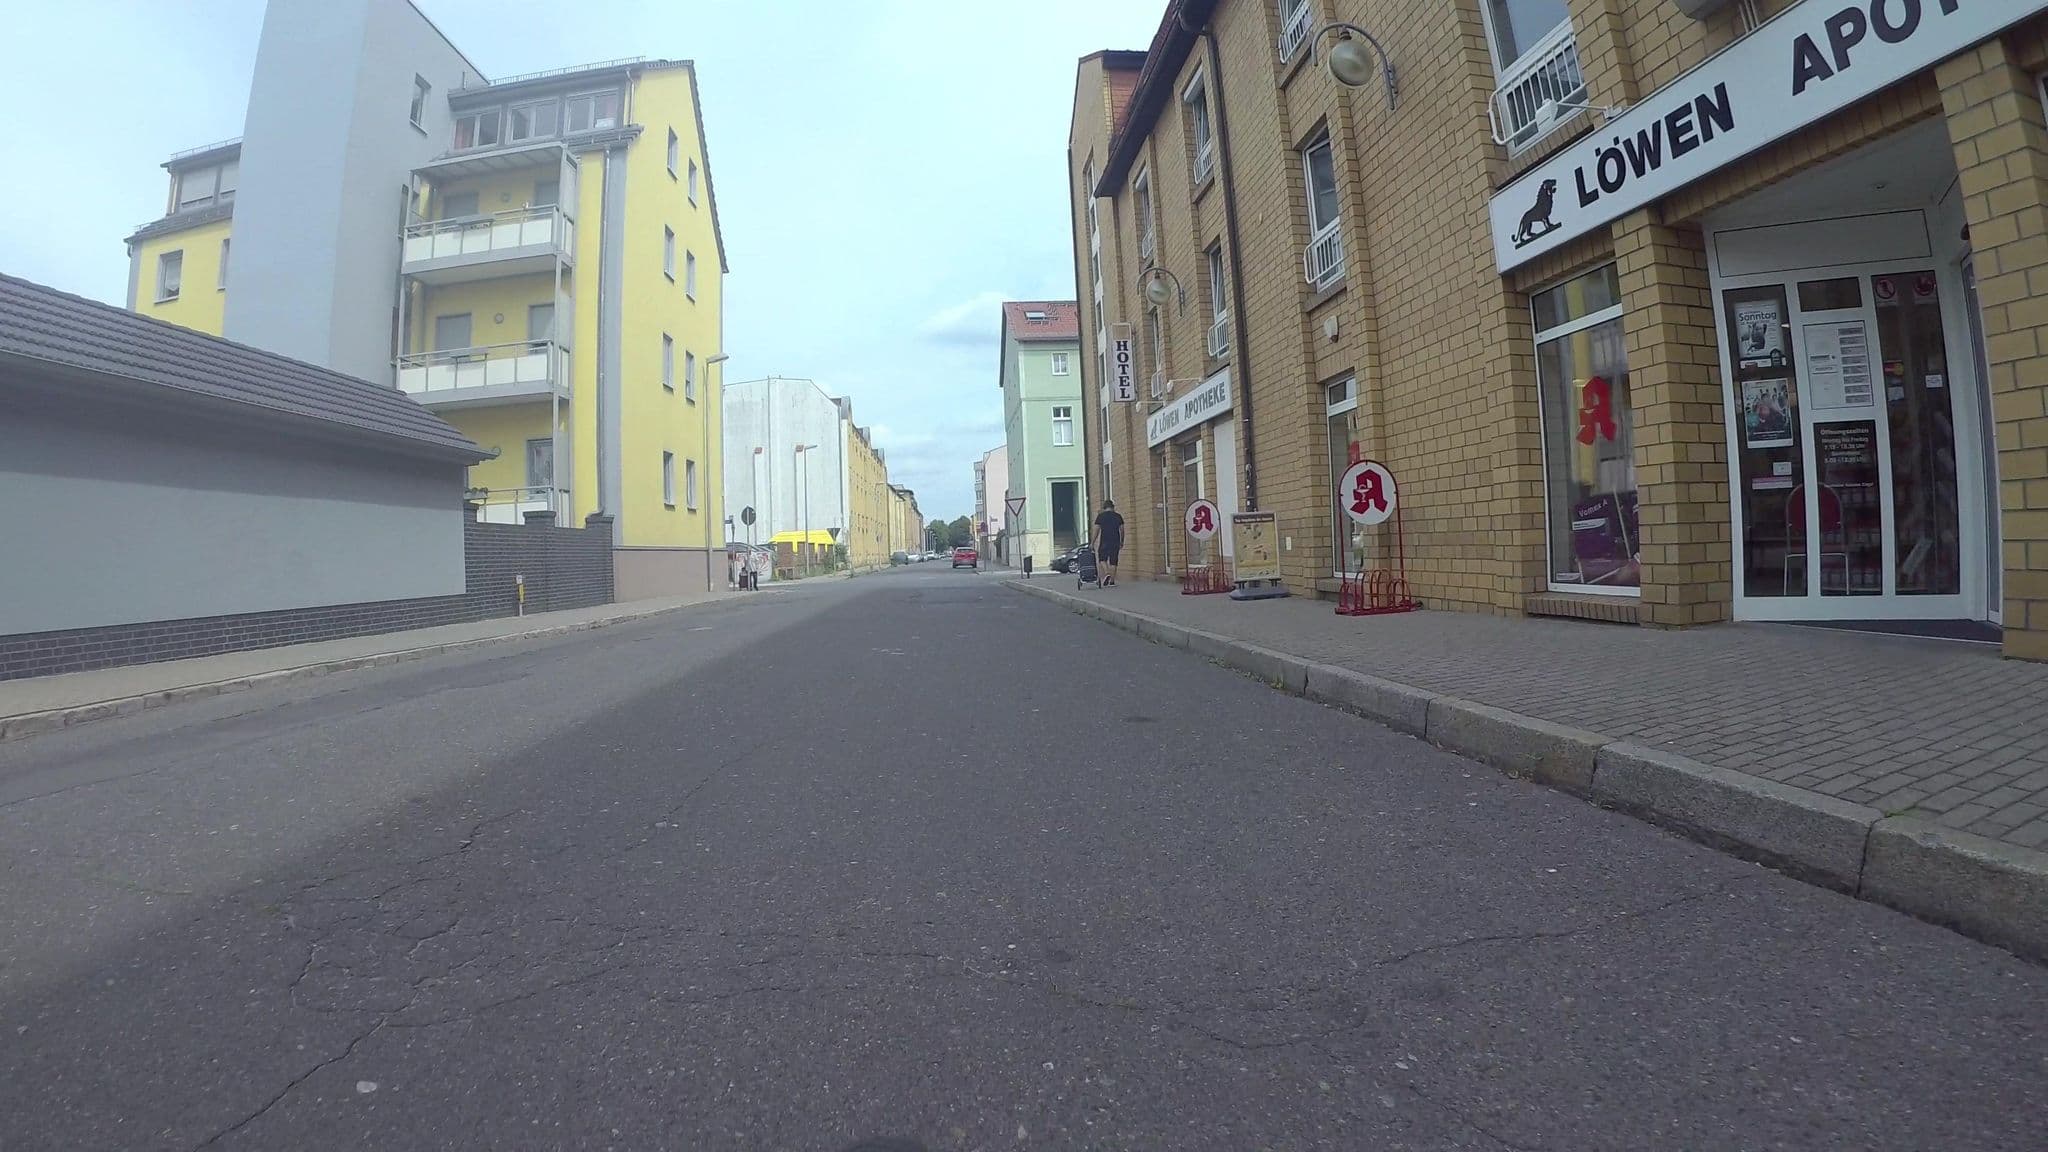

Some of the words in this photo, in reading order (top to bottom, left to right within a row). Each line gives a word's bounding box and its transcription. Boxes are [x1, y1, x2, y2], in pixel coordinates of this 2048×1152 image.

[1574, 81, 1735, 208] LÖWEN
[1792, 0, 1959, 96] APO
[1115, 340, 1130, 399] HOTEL
[1160, 407, 1180, 433] LÖWEN
[1184, 381, 1226, 420] APOTHEKE
